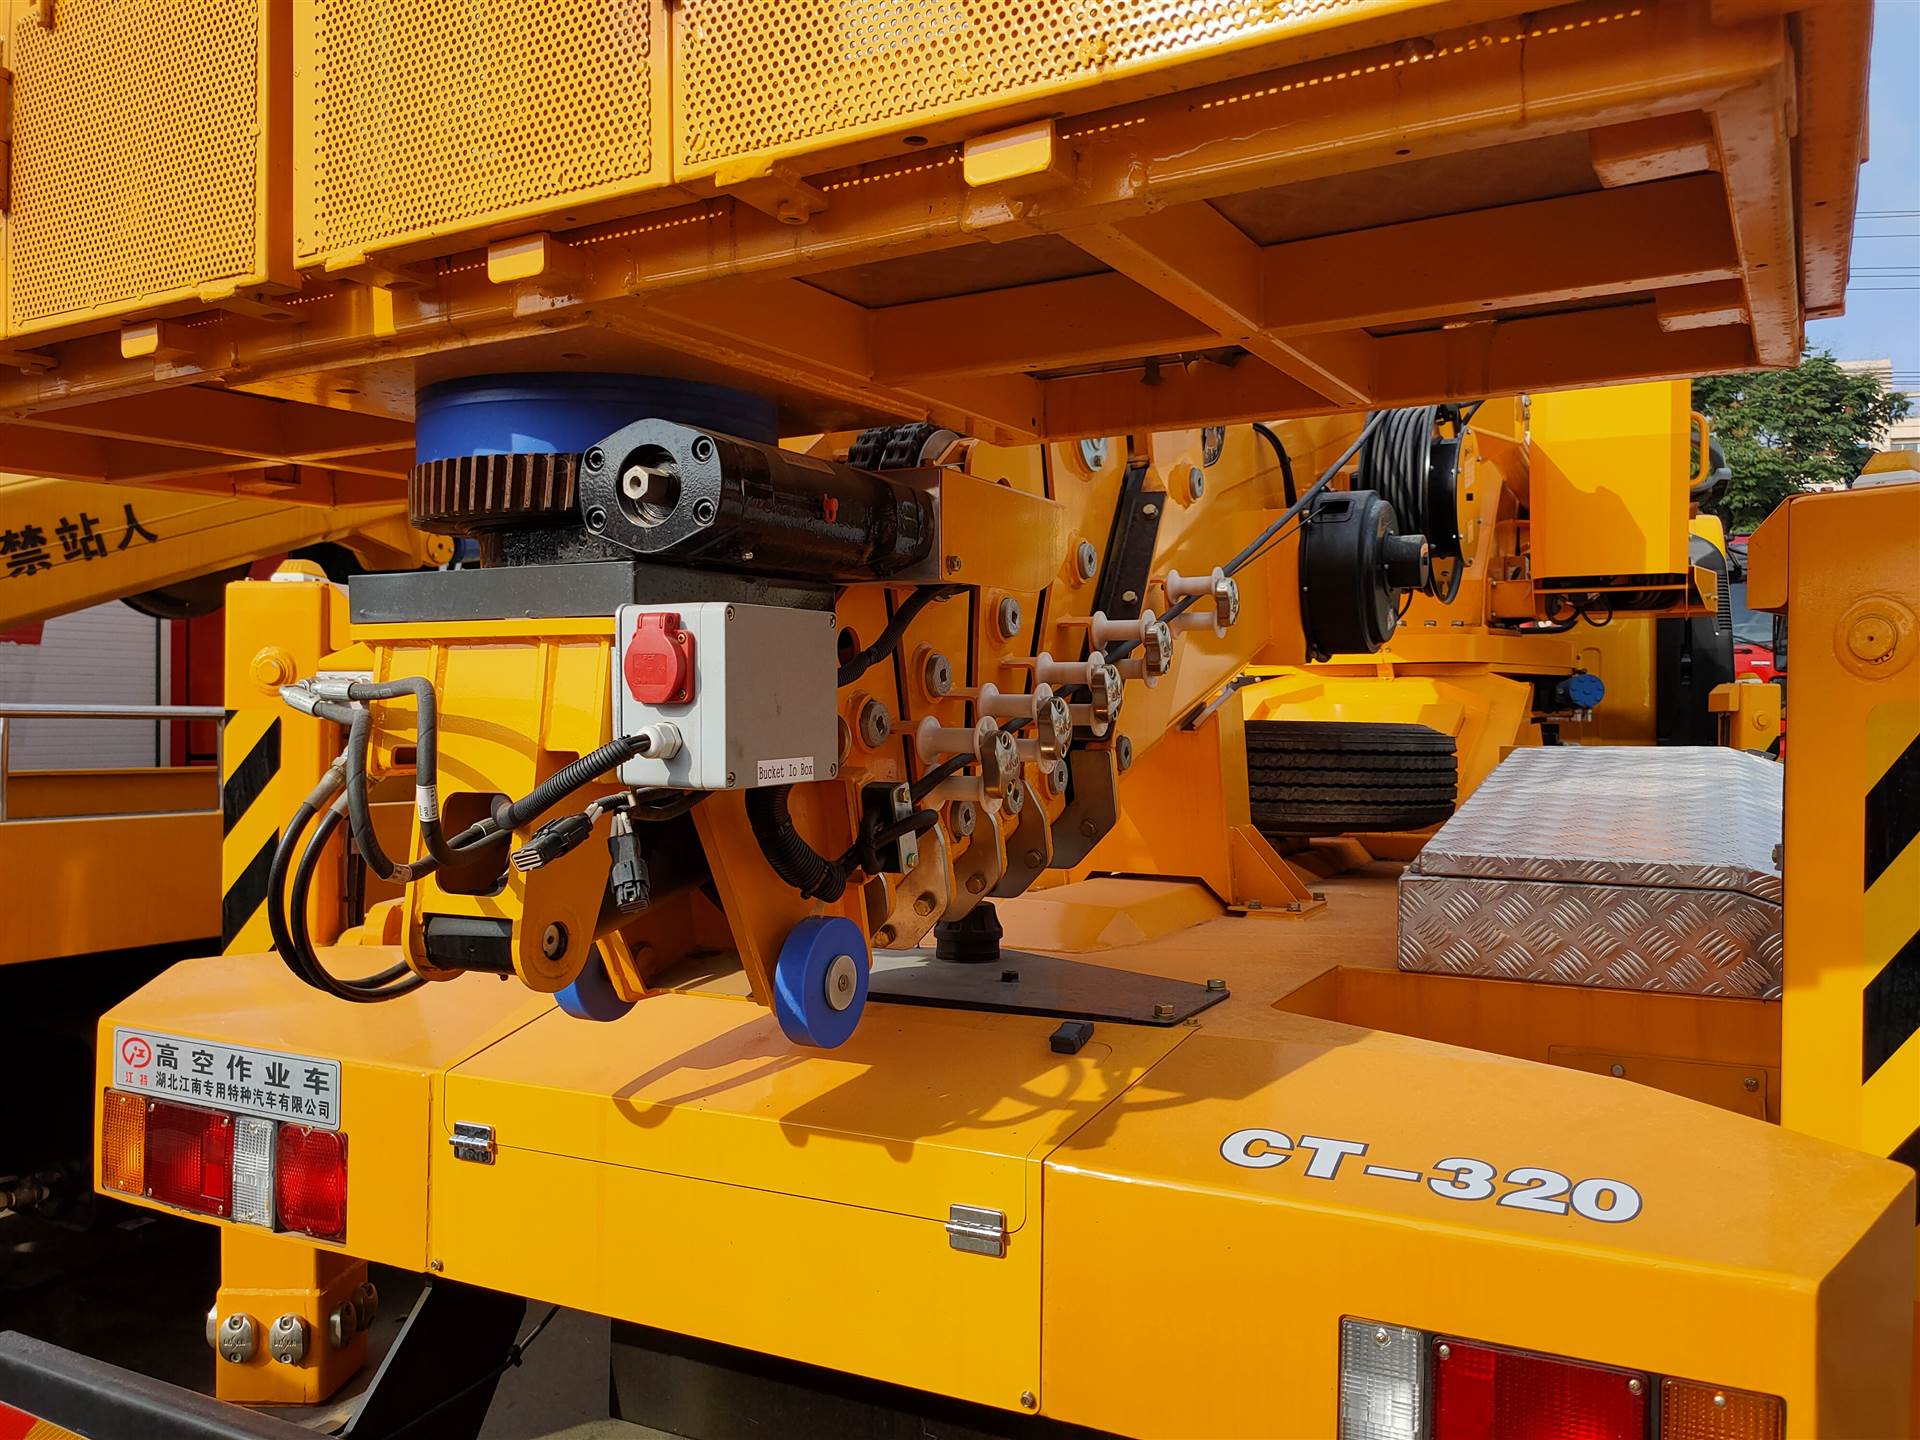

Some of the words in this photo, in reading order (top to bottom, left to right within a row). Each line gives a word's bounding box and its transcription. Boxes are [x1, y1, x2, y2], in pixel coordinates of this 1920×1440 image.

[759, 764, 785, 780] Bucket
[800, 762, 813, 776] Box
[156, 1043, 330, 1096] 高空作业车
[156, 1071, 330, 1120] 湖北江南专用特种汽车有限公司
[1219, 1127, 1643, 1224] CT-320
